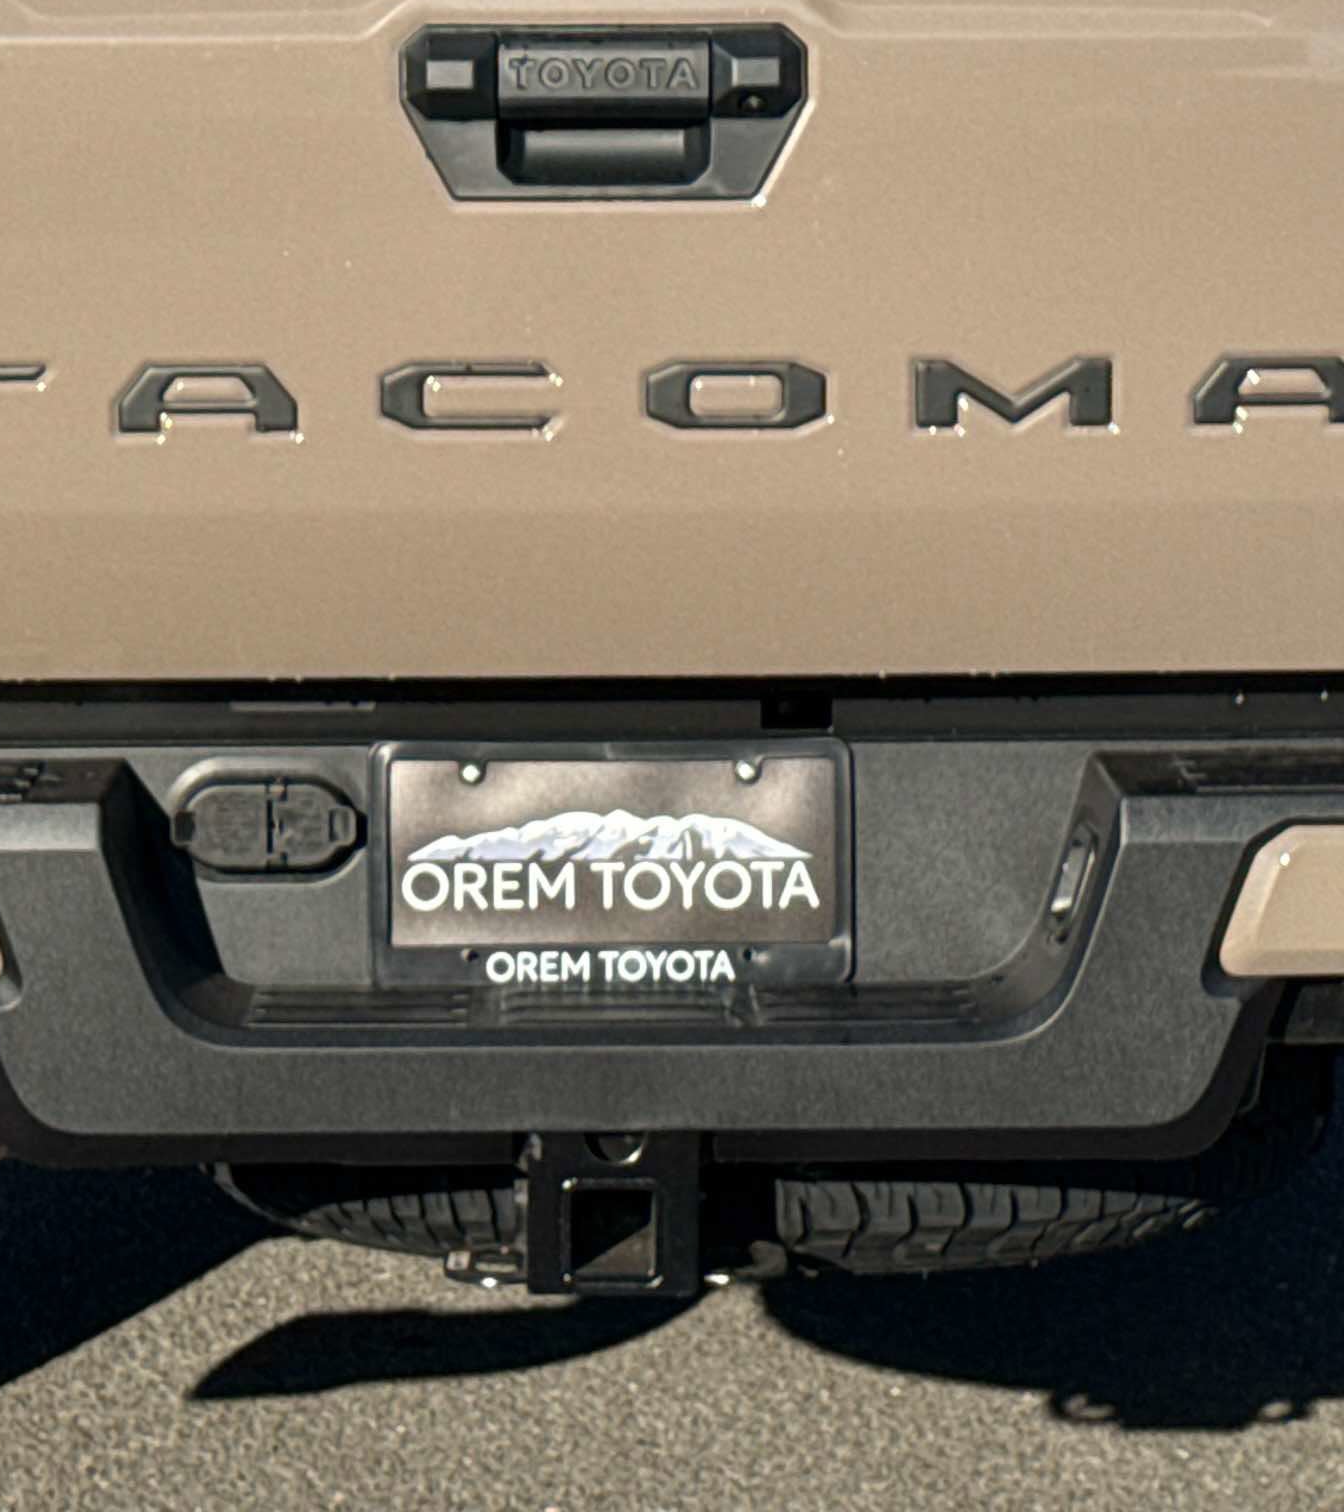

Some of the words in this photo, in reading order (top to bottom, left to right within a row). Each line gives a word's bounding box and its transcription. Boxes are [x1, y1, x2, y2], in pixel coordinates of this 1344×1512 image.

[507, 55, 698, 91] TOYOTA
[401, 861, 576, 912] OREM
[590, 860, 821, 912] TOYOTA
[485, 950, 591, 983] OREM
[598, 949, 736, 983] TOYOTA
